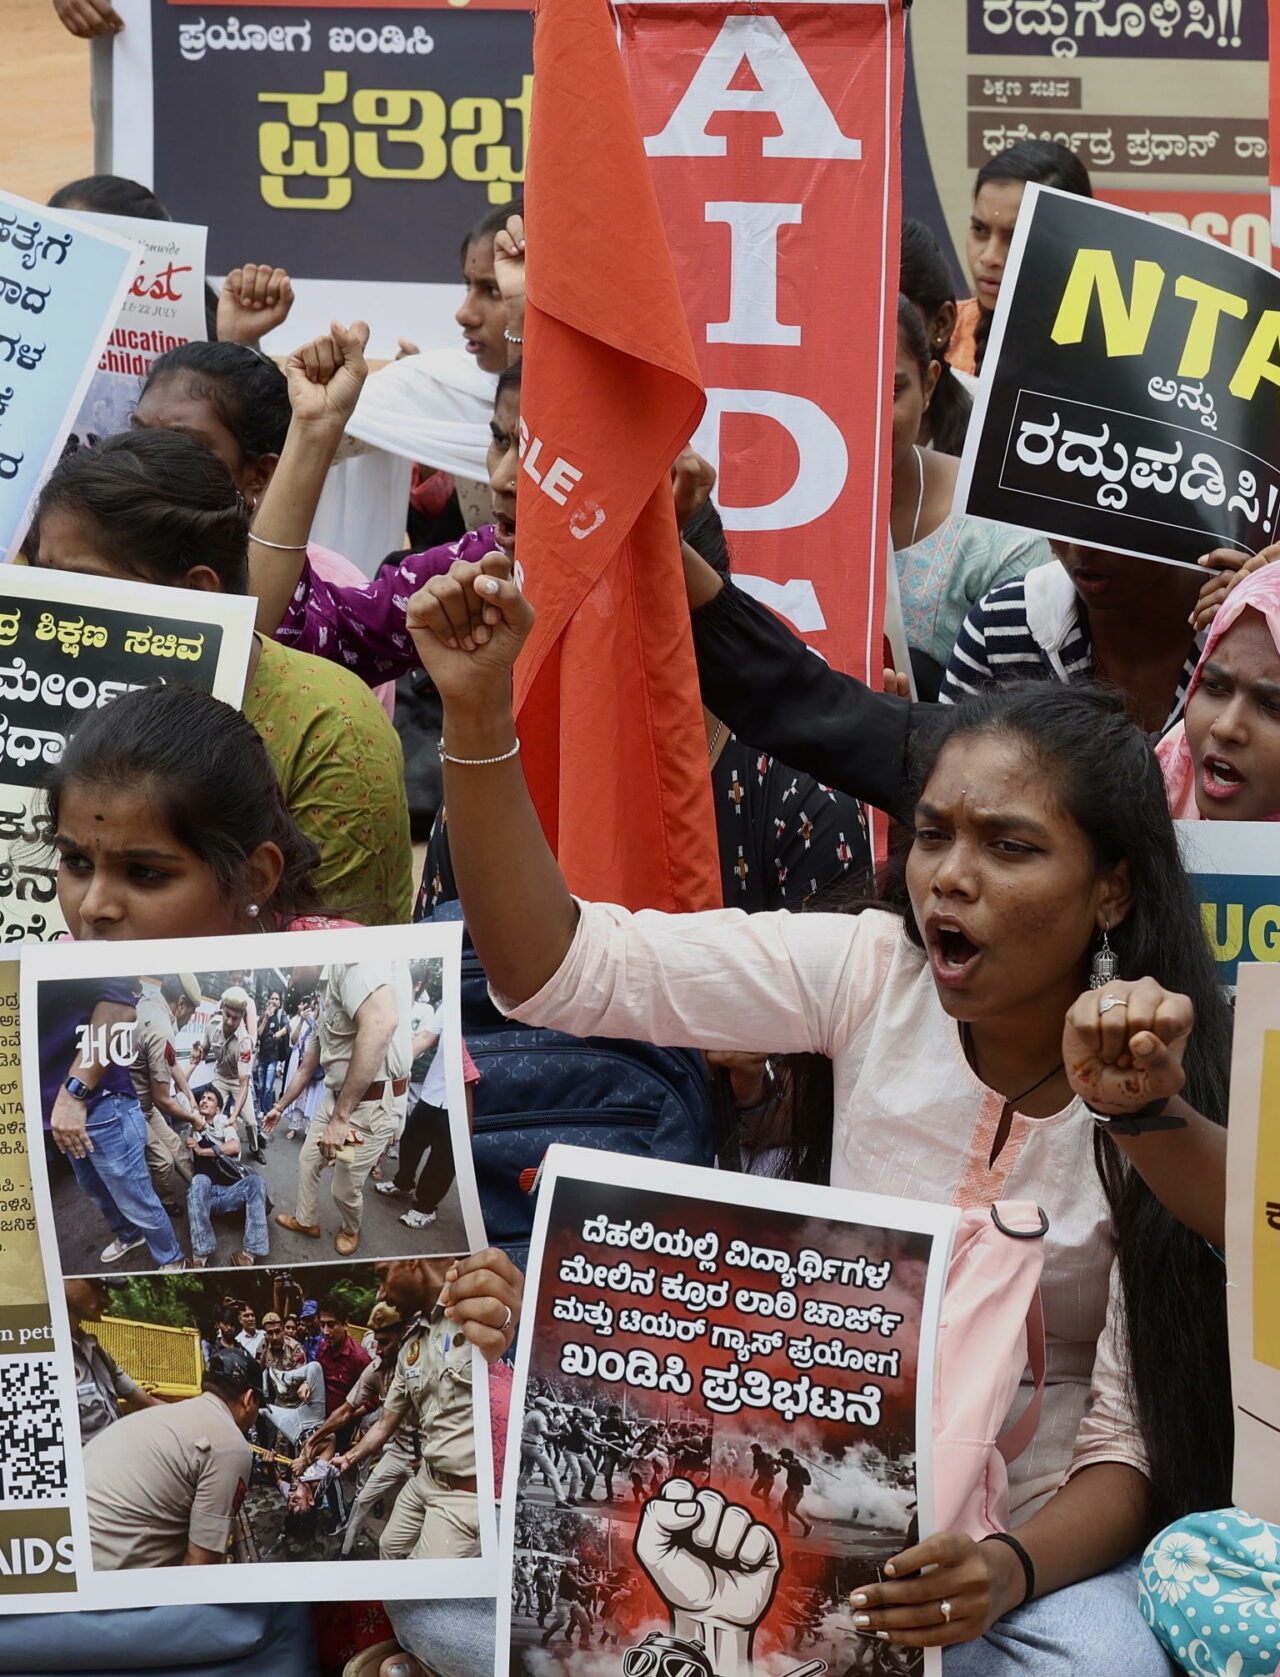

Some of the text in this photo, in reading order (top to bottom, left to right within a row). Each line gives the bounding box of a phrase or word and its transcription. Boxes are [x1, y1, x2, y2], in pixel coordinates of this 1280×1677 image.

[178, 16, 435, 60] ಪ್ರಯೋಗ ಖಂಡಿಸಿ
[983, 78, 1070, 103] ಶಿಕ್ಷಣ ಸಚಿವ
[151, 304, 178, 319] JULY
[1148, 376, 1218, 431] ಅನ್ನು
[1015, 412, 1278, 534] ರದ್ದುಪಡಿಸಿ!
[35, 613, 108, 658] ಶಿಕ್ಷಣ
[124, 626, 204, 662] ಸಚಿವ
[75, 1020, 139, 1069] HT
[582, 1215, 891, 1289] ದೆಹಲಿಯಲ್ಲಿ ವಿದ್ಯಾರ್ಥಿಗಳ
[560, 1256, 902, 1335] ಮೇಲಿನ ಕ್ರೂರ ಲಾಠಿ ಚಾರ್ಜ್
[553, 1297, 898, 1376] ಮತ್ತು ಟಿಯರ್ ಗ್ಯಾಸ್ ಪ್ರಯೋಗ
[561, 1343, 882, 1426] ಖಂಡಿಸಿ ಪ್ರತಿಭಟನೆ
